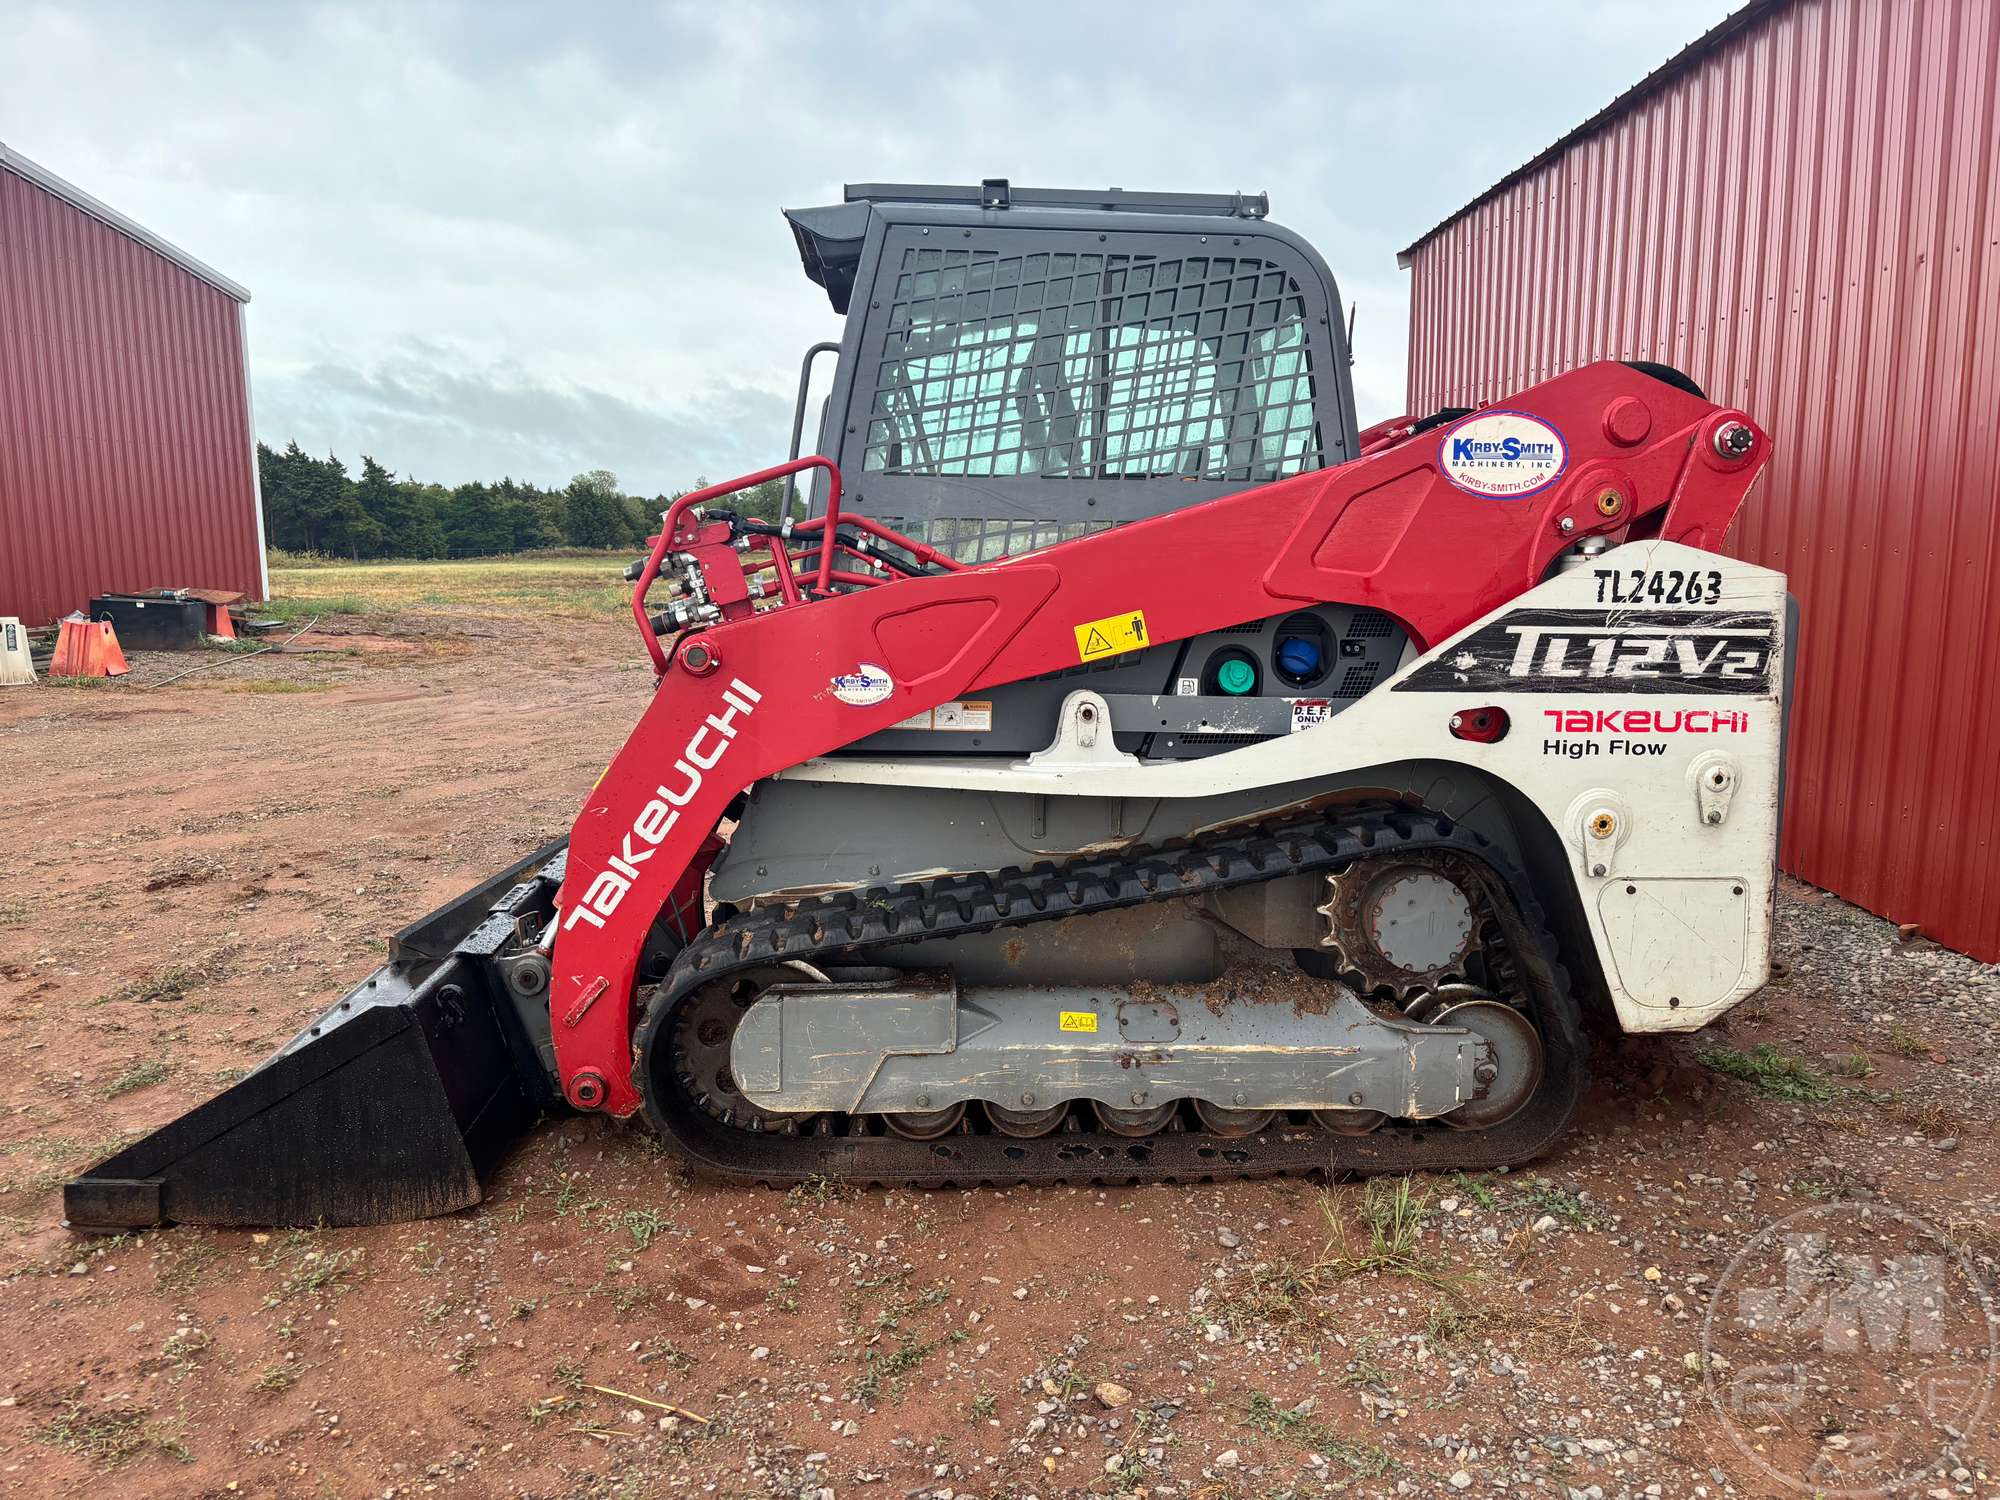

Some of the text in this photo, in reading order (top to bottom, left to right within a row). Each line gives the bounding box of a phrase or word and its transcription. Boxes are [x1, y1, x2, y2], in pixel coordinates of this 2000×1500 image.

[1452, 437, 1554, 461] KIRBY-SMITH
[1452, 460, 1525, 469] MACHINERY,
[1458, 471, 1546, 492] KIRBY-SMITH.COM
[1593, 569, 1723, 604] TL24263
[1543, 739, 1667, 759] High Flow
